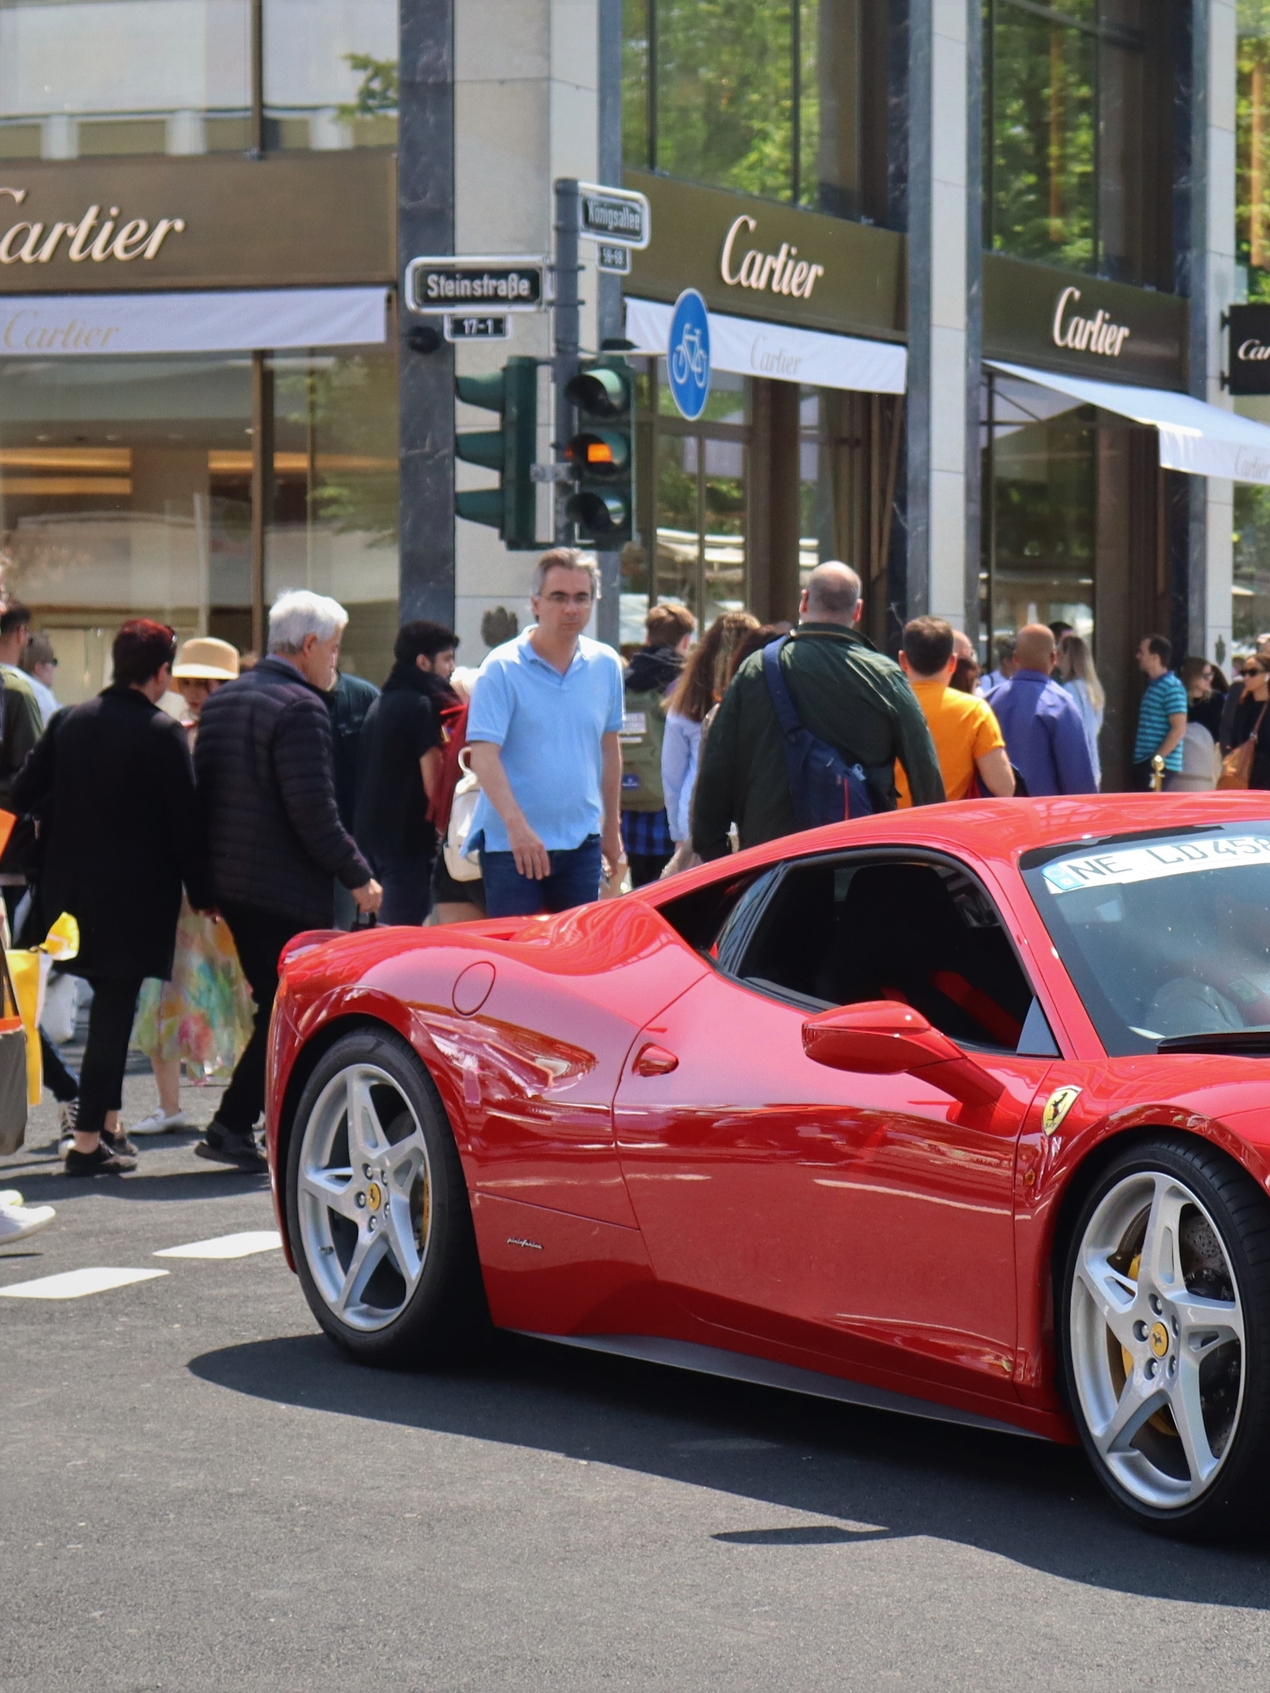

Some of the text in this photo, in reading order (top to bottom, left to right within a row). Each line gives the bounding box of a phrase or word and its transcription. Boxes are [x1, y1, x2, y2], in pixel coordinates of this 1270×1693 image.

[588, 200, 640, 231] Königsallee
[721, 214, 824, 299] Cartier
[427, 273, 531, 299] Steinstraße
[4, 308, 121, 350] Cartier
[462, 318, 494, 335] 17-1
[1053, 286, 1130, 357] Cartier
[750, 333, 802, 375] Cartier
[1067, 855, 1134, 881] NE
